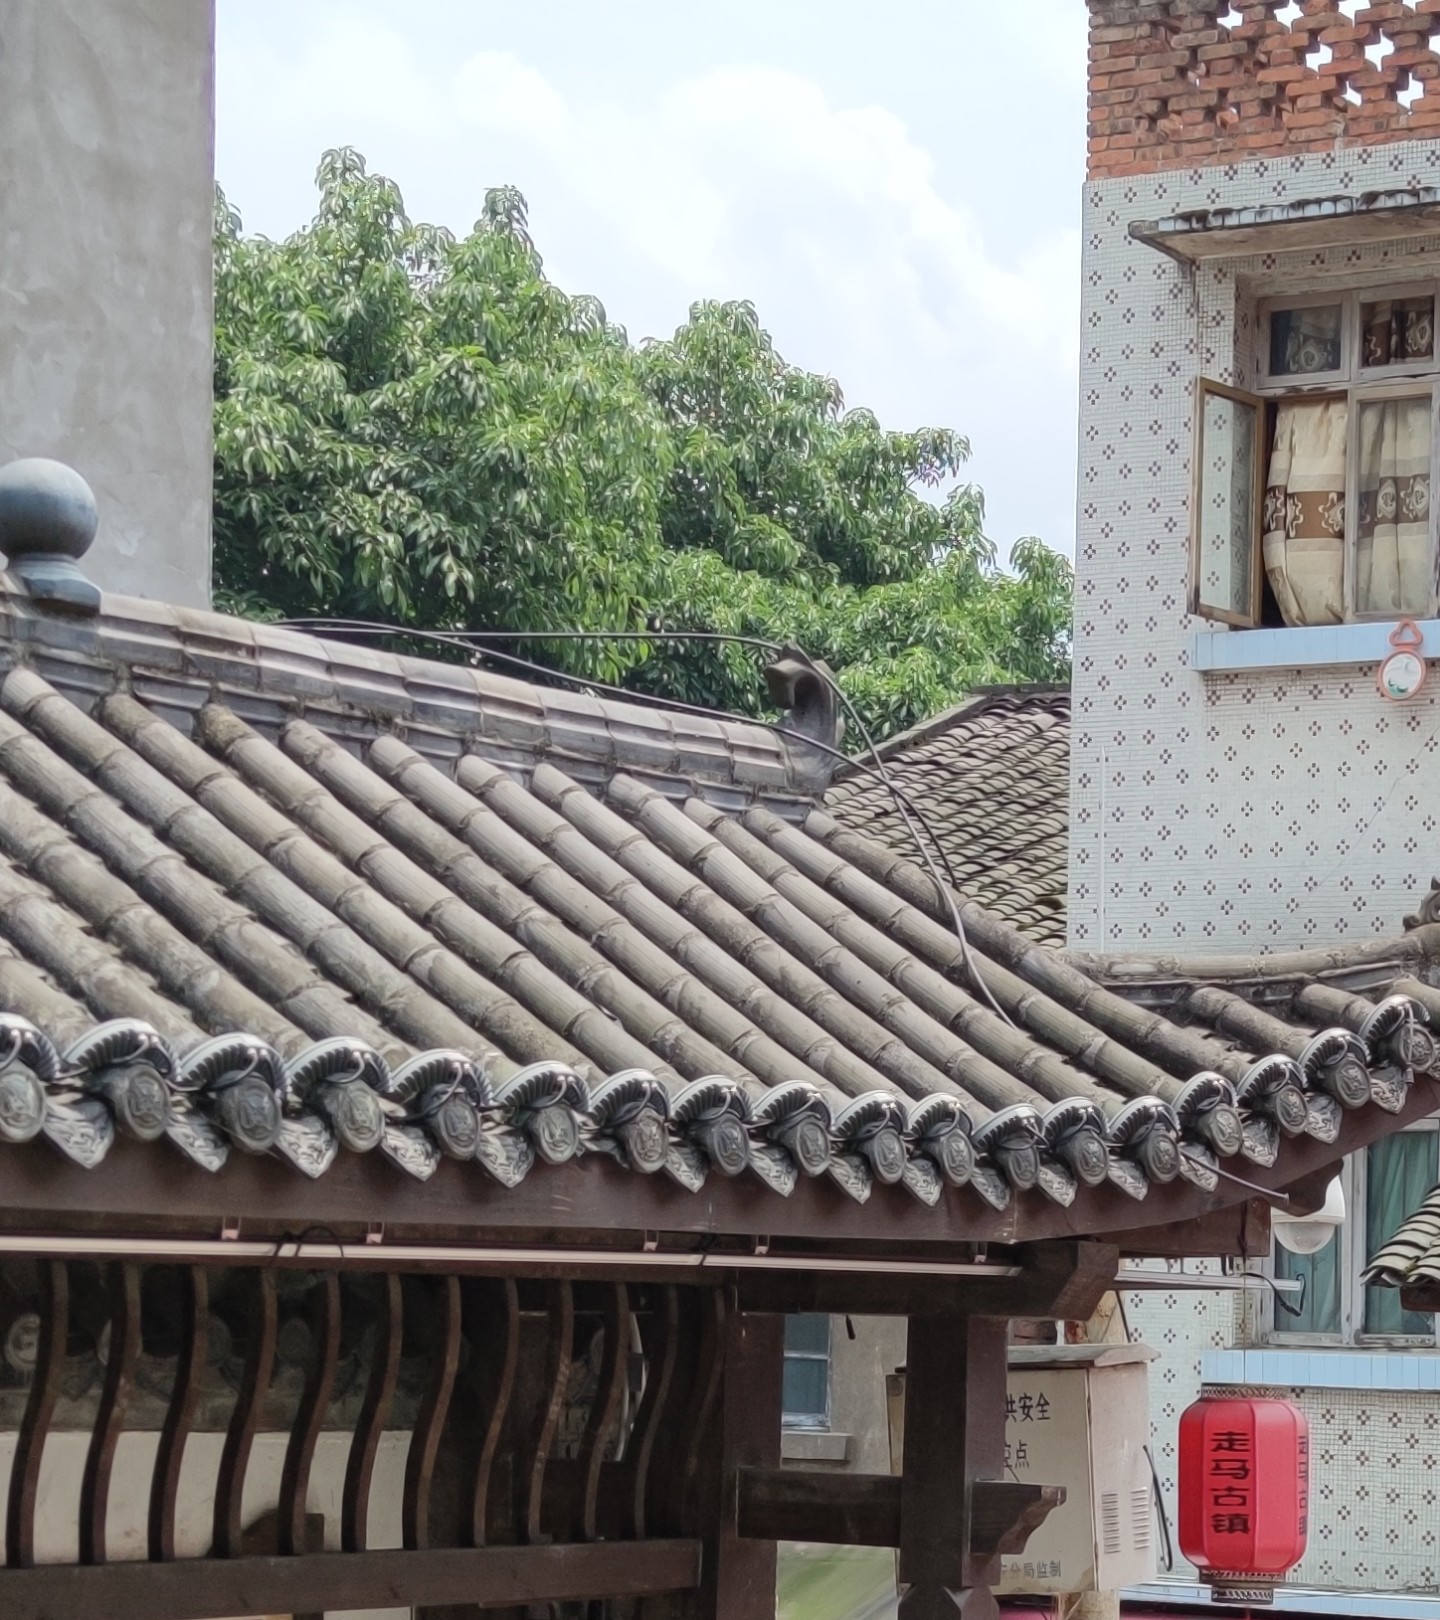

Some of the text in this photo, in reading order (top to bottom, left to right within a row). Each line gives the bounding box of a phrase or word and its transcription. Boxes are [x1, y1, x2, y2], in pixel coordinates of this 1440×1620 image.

[1211, 1431, 1251, 1535] 走马古镇
[1002, 1561, 1062, 1579] 分局监制
